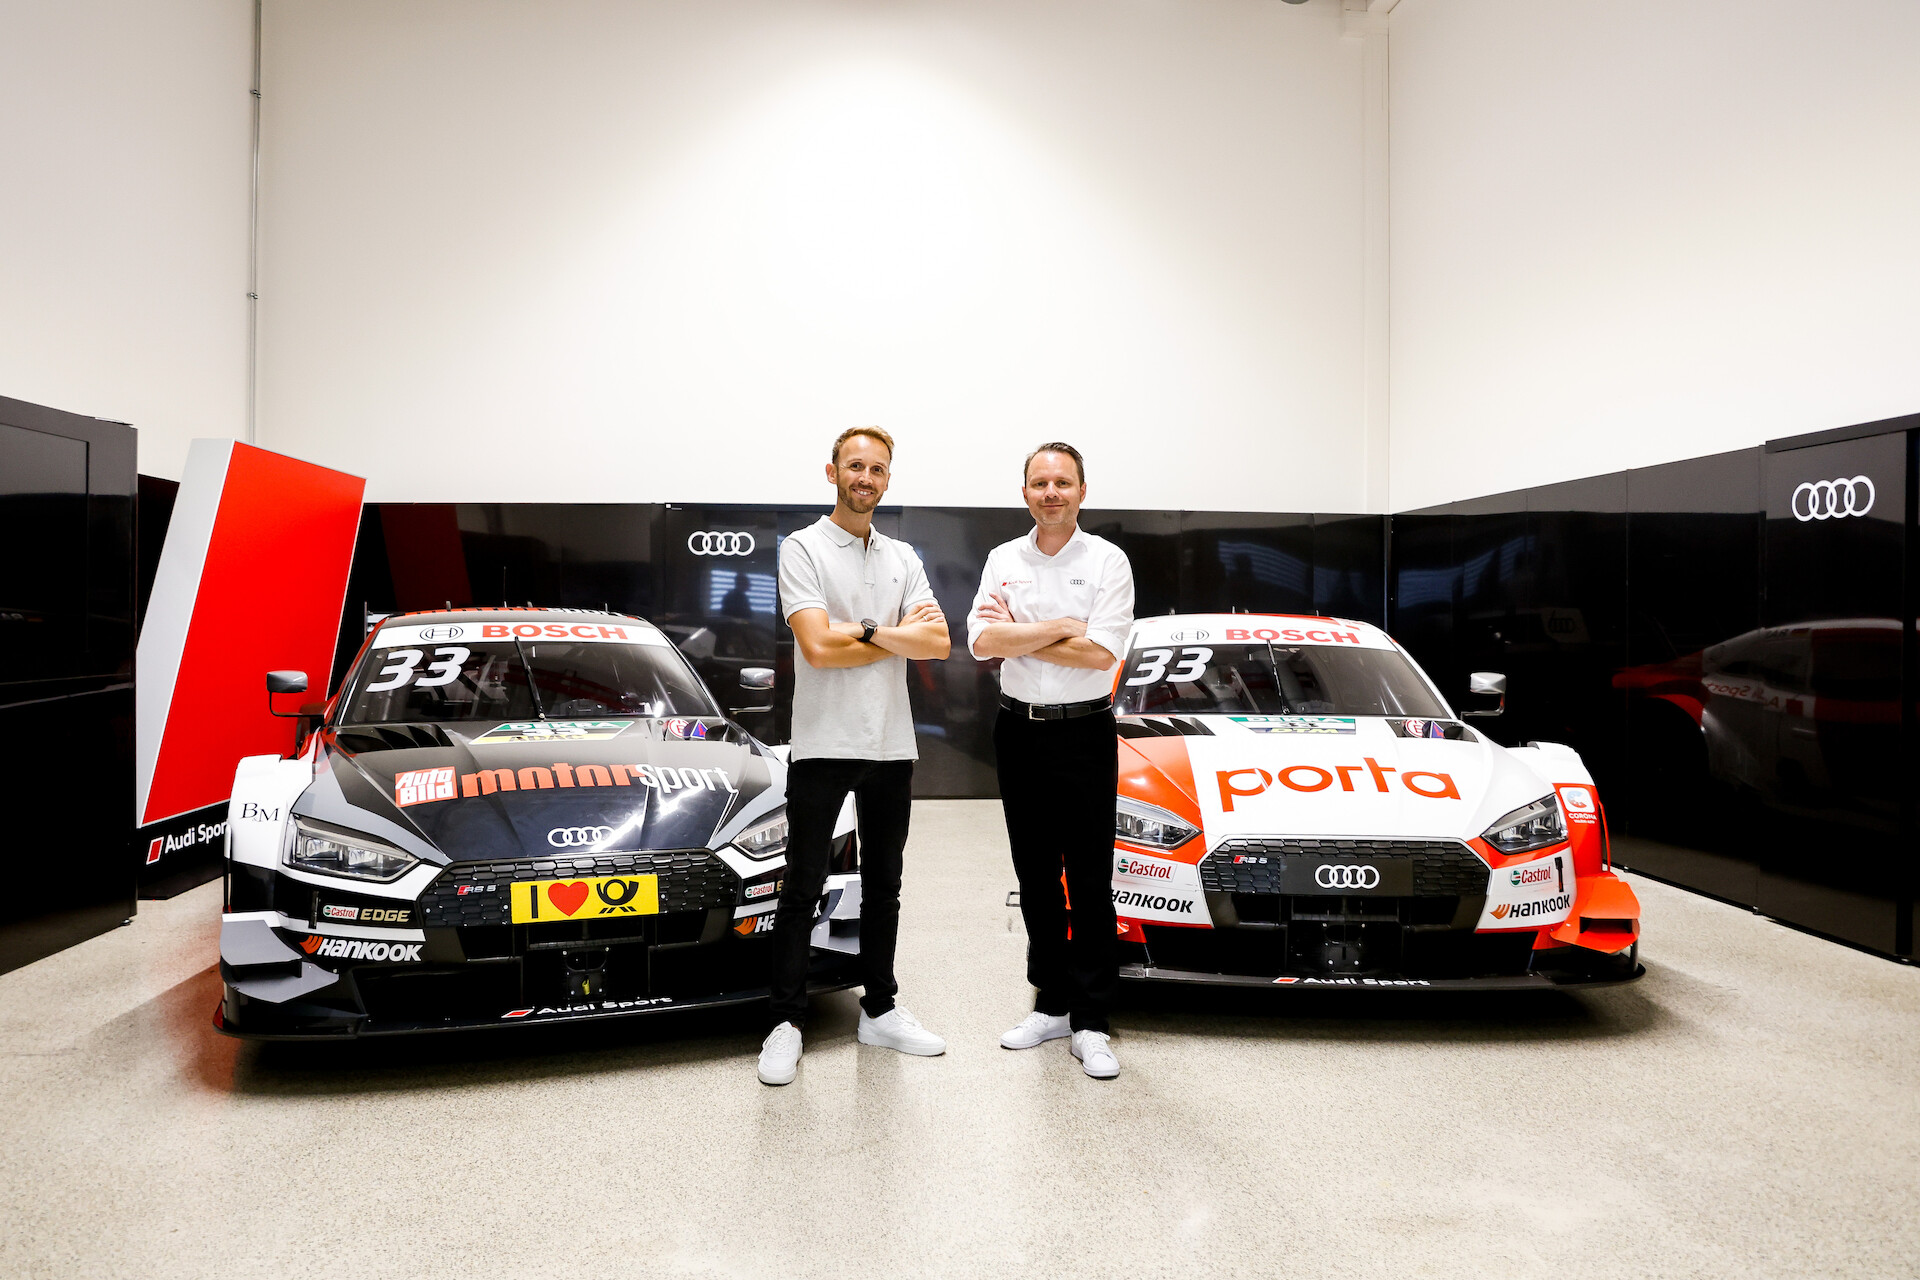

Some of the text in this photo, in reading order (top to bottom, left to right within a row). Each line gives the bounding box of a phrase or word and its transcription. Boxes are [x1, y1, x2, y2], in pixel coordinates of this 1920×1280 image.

[482, 624, 629, 640] BOSCH
[1225, 628, 1360, 644] BOSCH
[366, 646, 470, 692] 33
[1125, 647, 1213, 687] 33
[395, 768, 454, 790] Auto
[1216, 757, 1462, 813] porta
[165, 821, 229, 854] Audi Spor
[1129, 860, 1173, 879] Castrol
[1521, 866, 1552, 884] Castrol
[753, 883, 774, 896] Castrol
[530, 884, 539, 919] I
[331, 906, 412, 923] Castrol EDGE
[1303, 977, 1431, 987] Audi Sport
[537, 997, 673, 1015] Audi Sport
